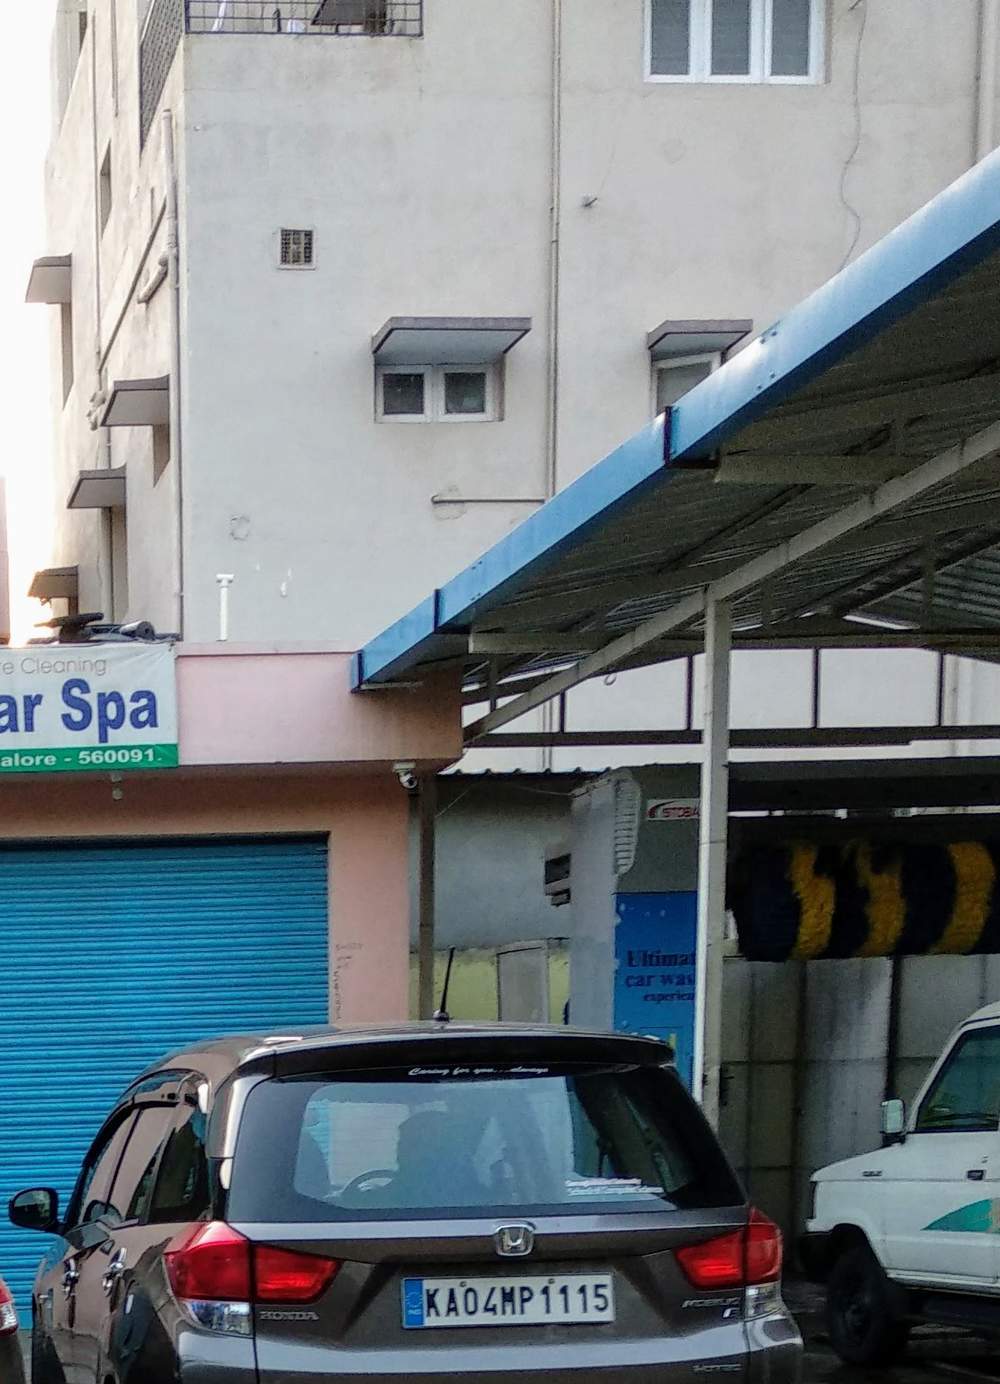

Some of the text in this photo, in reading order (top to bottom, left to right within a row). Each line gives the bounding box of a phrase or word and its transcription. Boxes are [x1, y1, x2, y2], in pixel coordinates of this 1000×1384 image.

[21, 657, 107, 676] Cleaning
[61, 678, 159, 743] Spa
[1, 753, 57, 767] alore
[625, 975, 656, 987] car
[425, 1284, 608, 1317] KA04MP1115
[259, 1311, 320, 1320] HONDA
